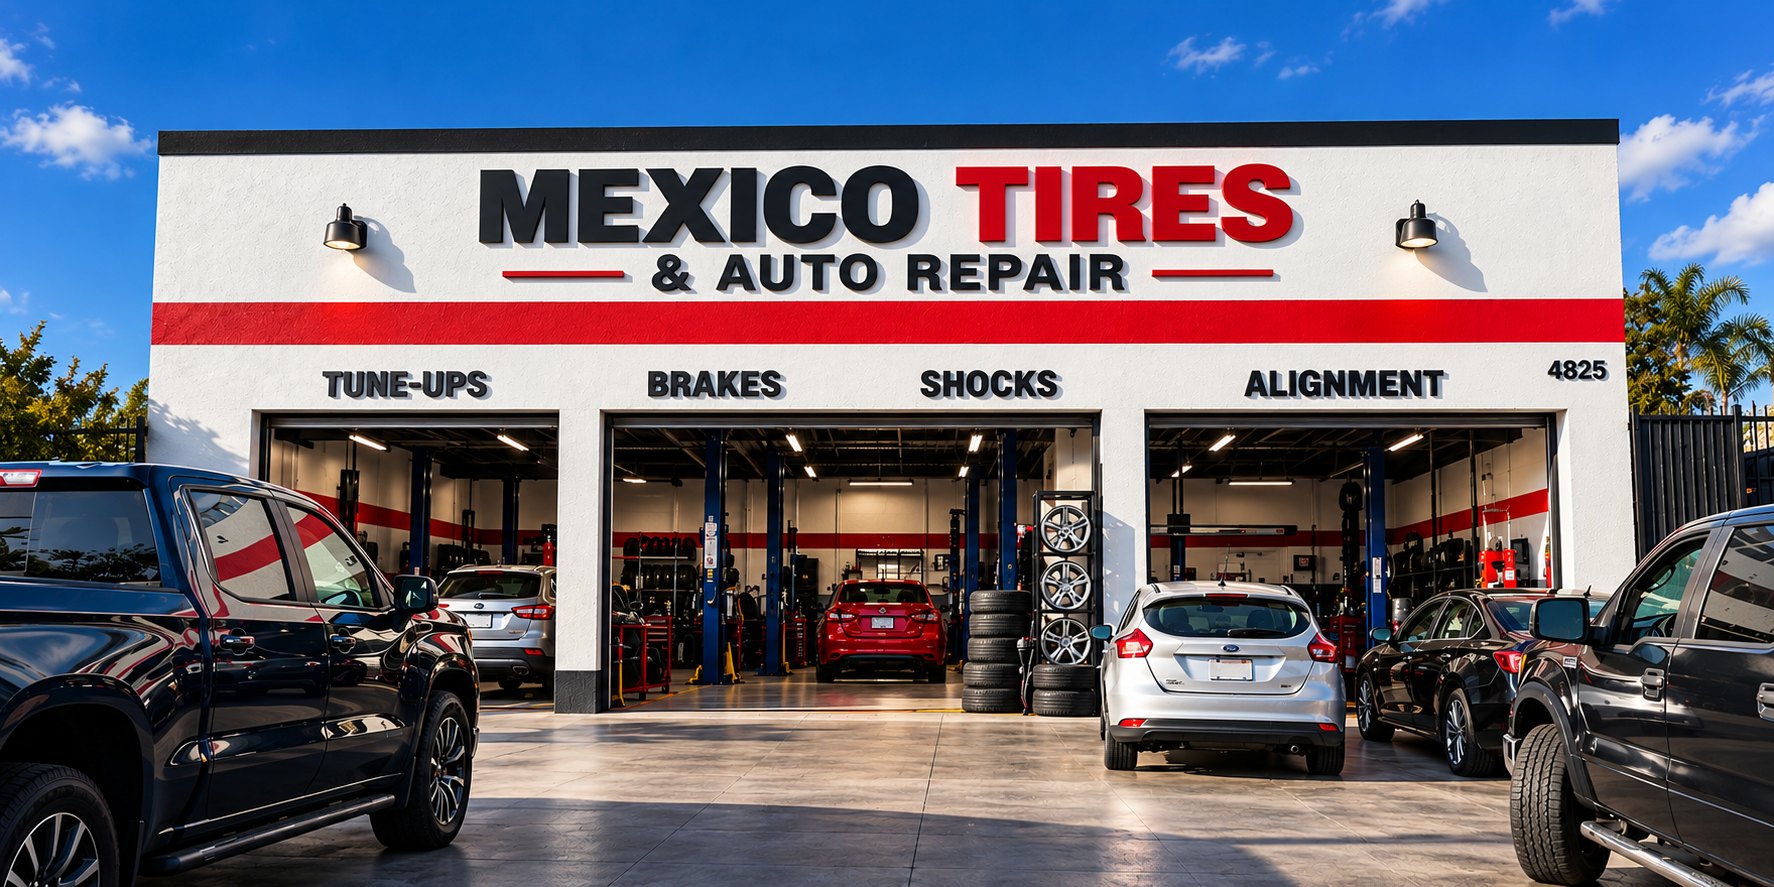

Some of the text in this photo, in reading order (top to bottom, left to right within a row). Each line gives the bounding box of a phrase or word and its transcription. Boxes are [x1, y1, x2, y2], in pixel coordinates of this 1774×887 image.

[479, 164, 1294, 245] MEXICO TIRES
[652, 253, 1125, 293] & AUTO REPAIR
[323, 370, 488, 399] TUNE-UPS
[647, 370, 782, 398] BRAKES
[920, 369, 1058, 398] SHOCKS
[1245, 369, 1445, 398] ALIGNMENT
[1547, 360, 1607, 380] 4825
